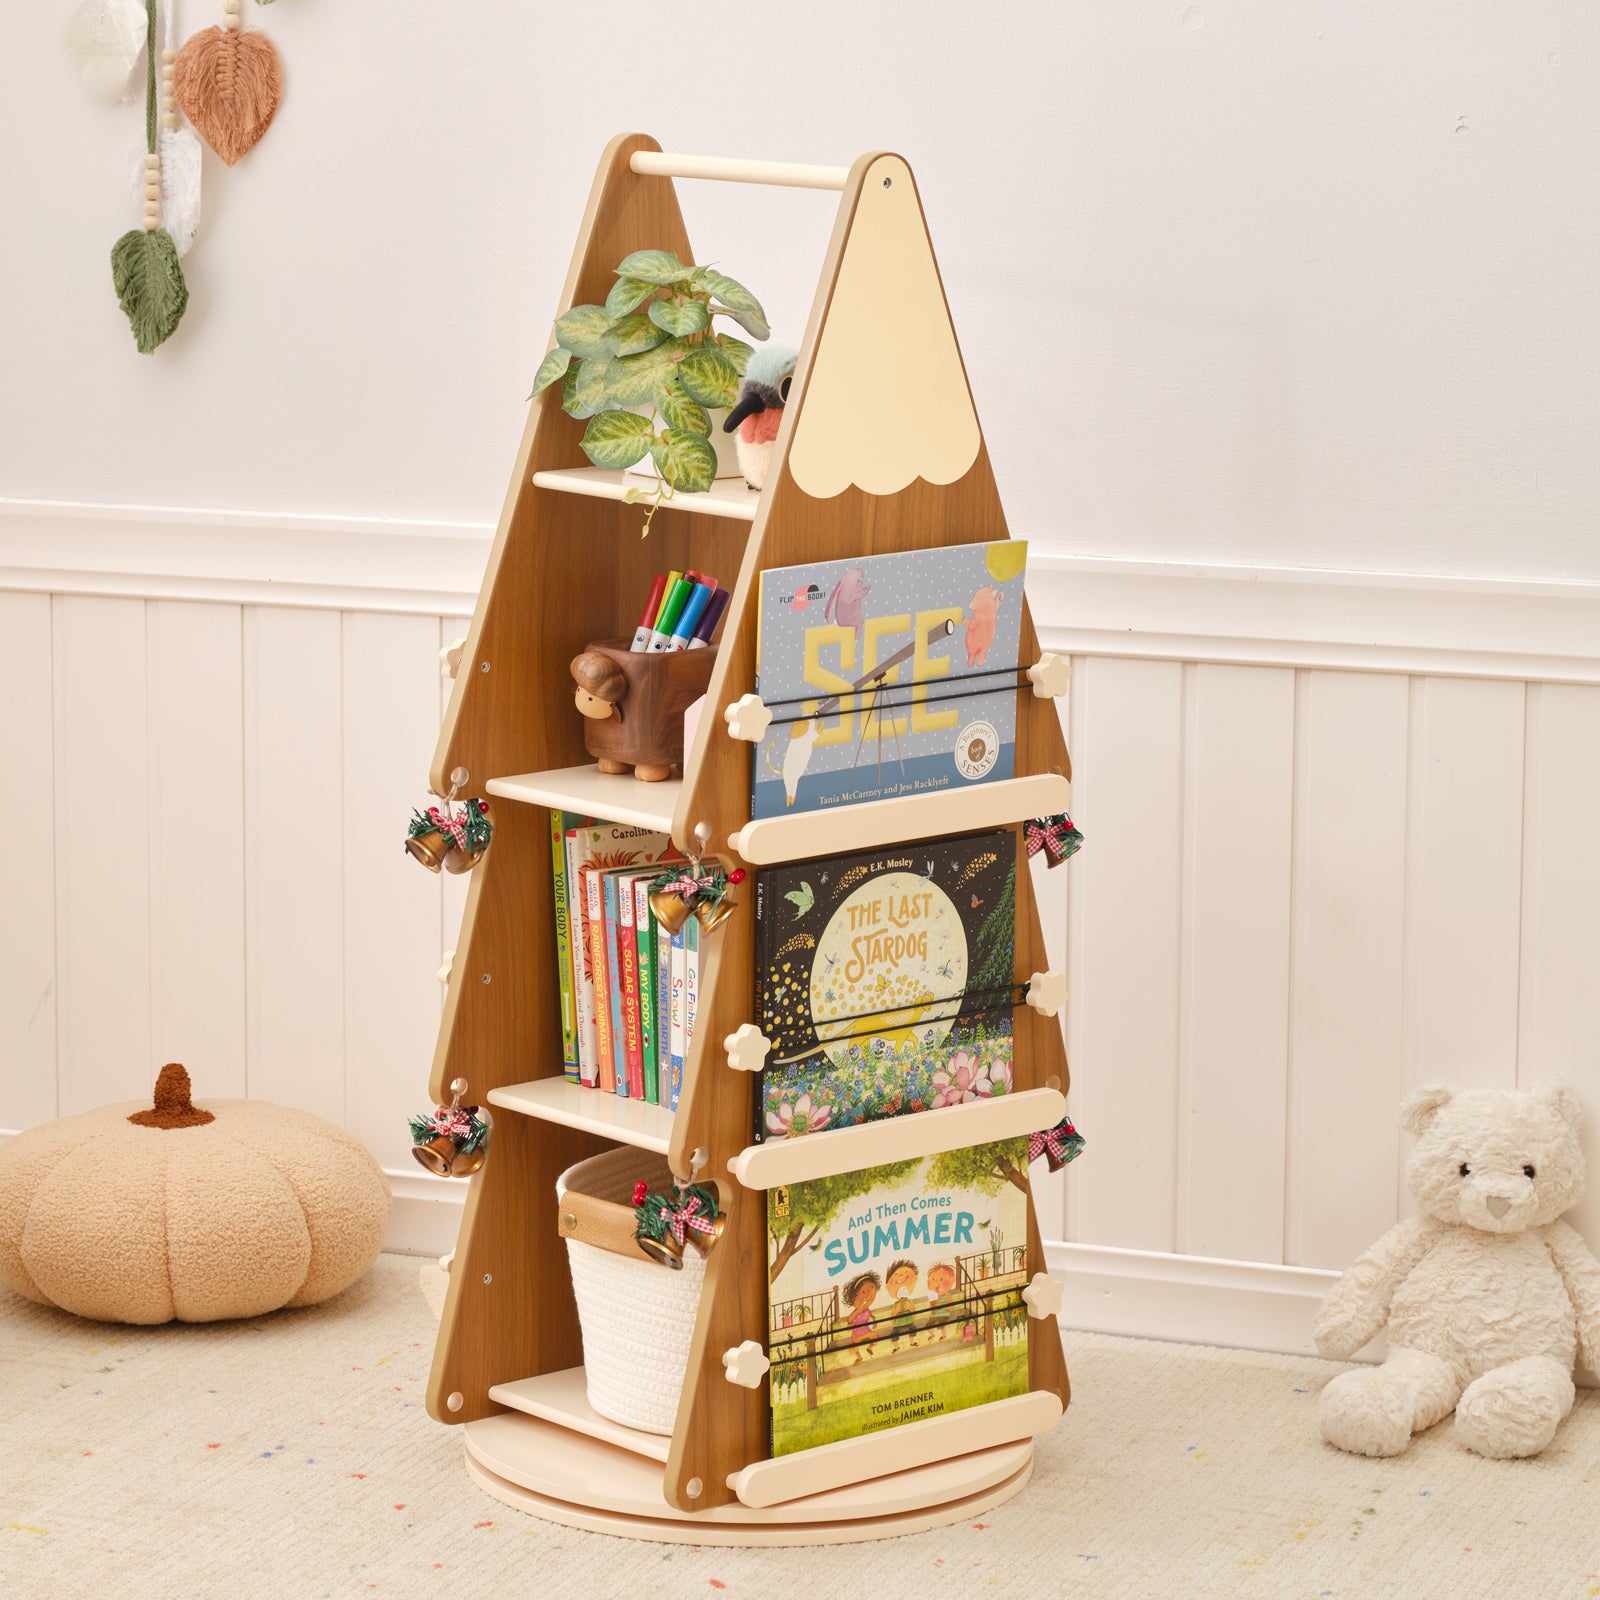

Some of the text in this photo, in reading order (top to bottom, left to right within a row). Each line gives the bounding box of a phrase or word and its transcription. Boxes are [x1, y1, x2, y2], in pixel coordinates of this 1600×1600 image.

[807, 592, 826, 601] BOOK!
[803, 607, 963, 749] SEE
[961, 749, 995, 774] SENSES
[819, 775, 949, 805] Tania McCartney and Jess Racklyeft
[611, 826, 653, 839] Caroline
[870, 857, 913, 873] E.K. Mosley
[554, 872, 564, 903] YOUR
[556, 907, 567, 939] BODY
[846, 893, 933, 931] THE LAST
[591, 925, 604, 999] RAINFOREST
[845, 928, 928, 983] STARDOG
[575, 963, 583, 996] Through
[624, 949, 636, 1052] SOLAR SYSTEM
[640, 969, 650, 1029] MY BODY
[660, 967, 669, 1055] PLANET EARTH
[672, 977, 682, 1028] Snow!
[687, 968, 696, 1037] Go Fishing
[578, 1016, 586, 1048] Through
[597, 1001, 607, 1055] ANIMALS
[848, 1196, 952, 1231] And Then Comes
[823, 1211, 975, 1277] SUMMER
[861, 1402, 944, 1431] illustrated by JAIME KIM
[871, 1391, 934, 1415] TOM BRENNER
